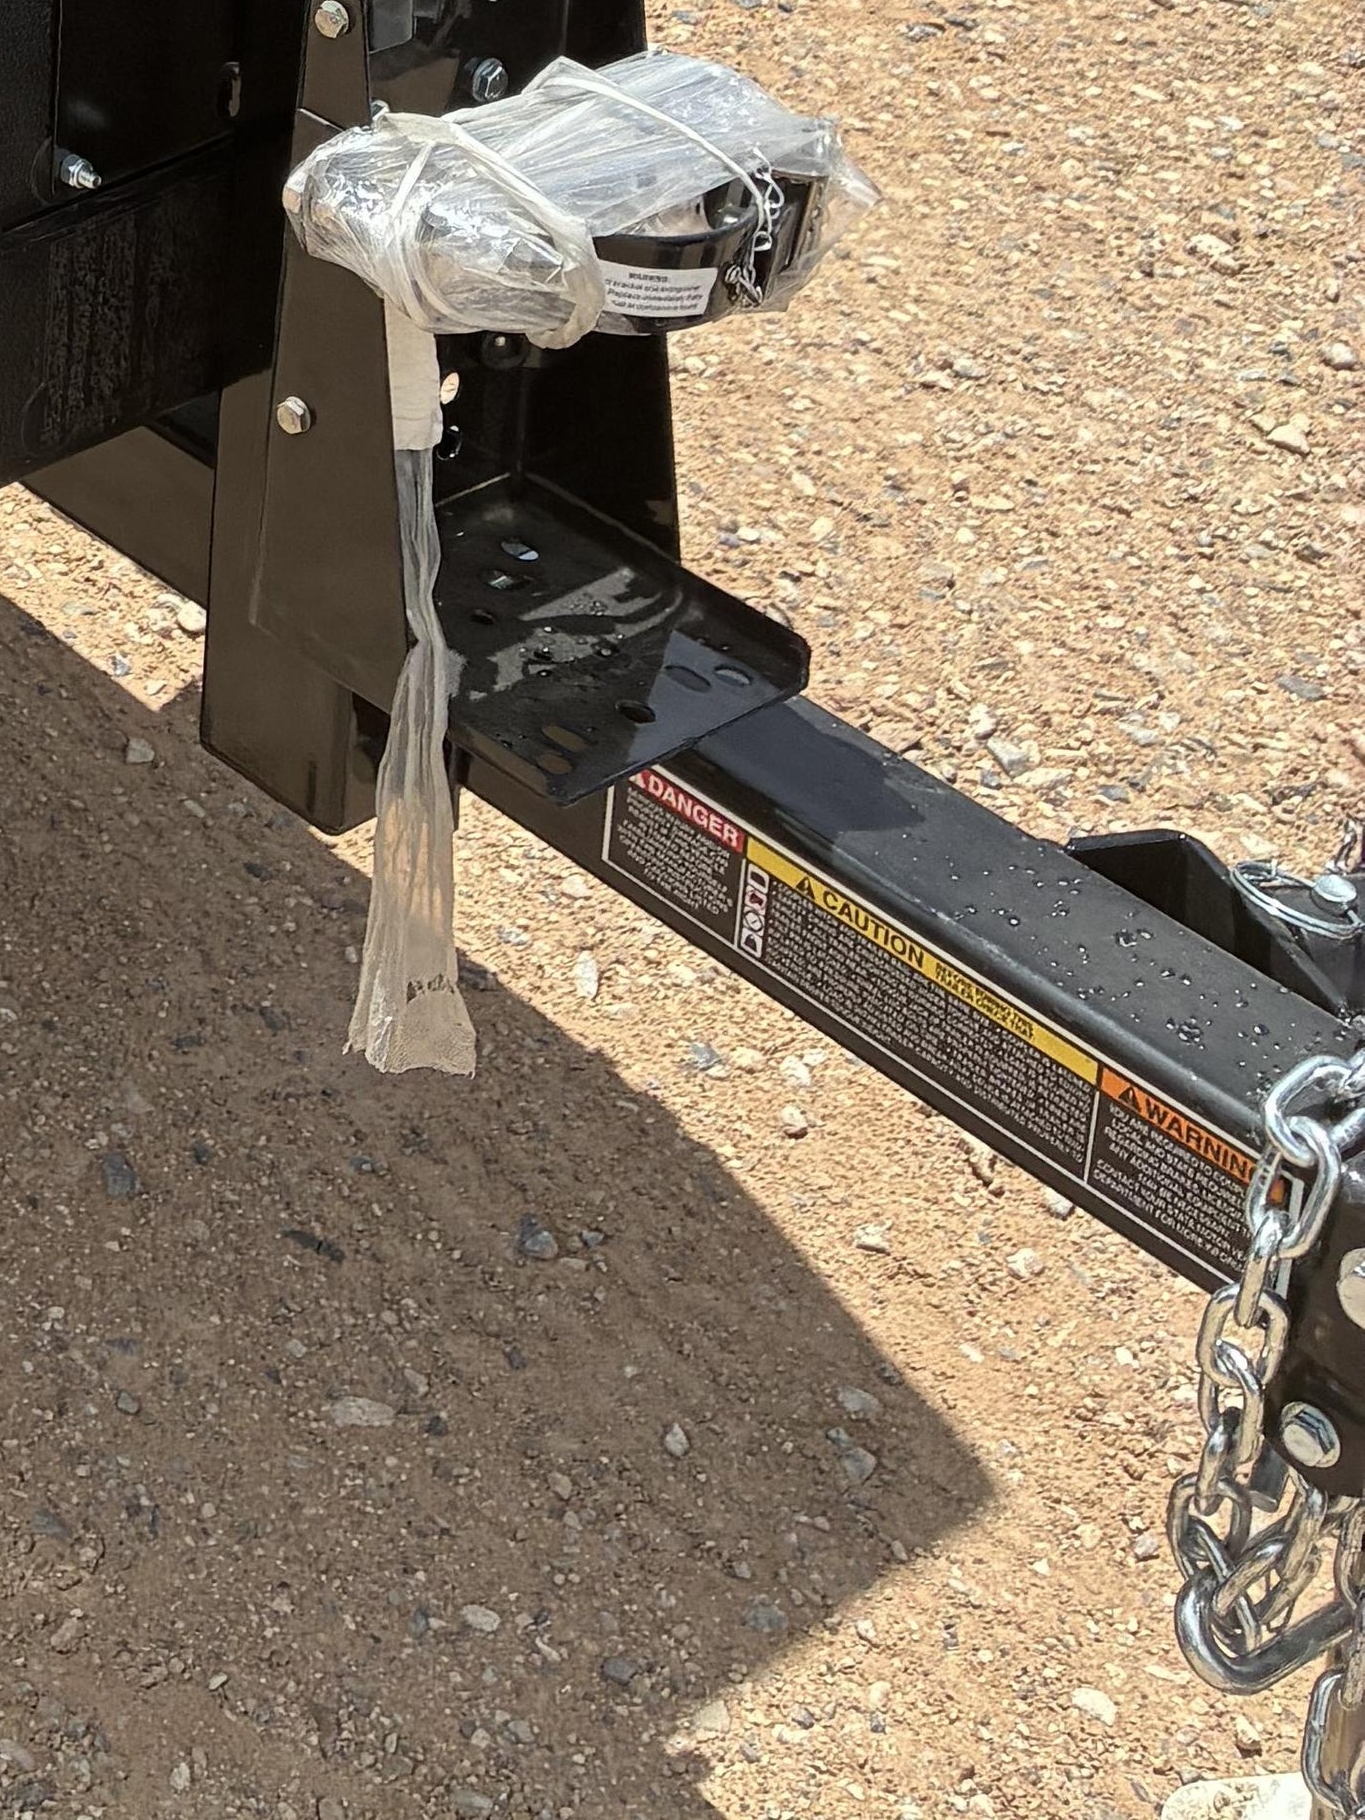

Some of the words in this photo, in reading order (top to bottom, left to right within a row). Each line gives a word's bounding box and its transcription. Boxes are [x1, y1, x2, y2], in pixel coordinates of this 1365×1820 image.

[647, 773, 738, 848] DANGER
[822, 890, 925, 970] CAUTION
[1146, 1097, 1254, 1181] WARNIN
